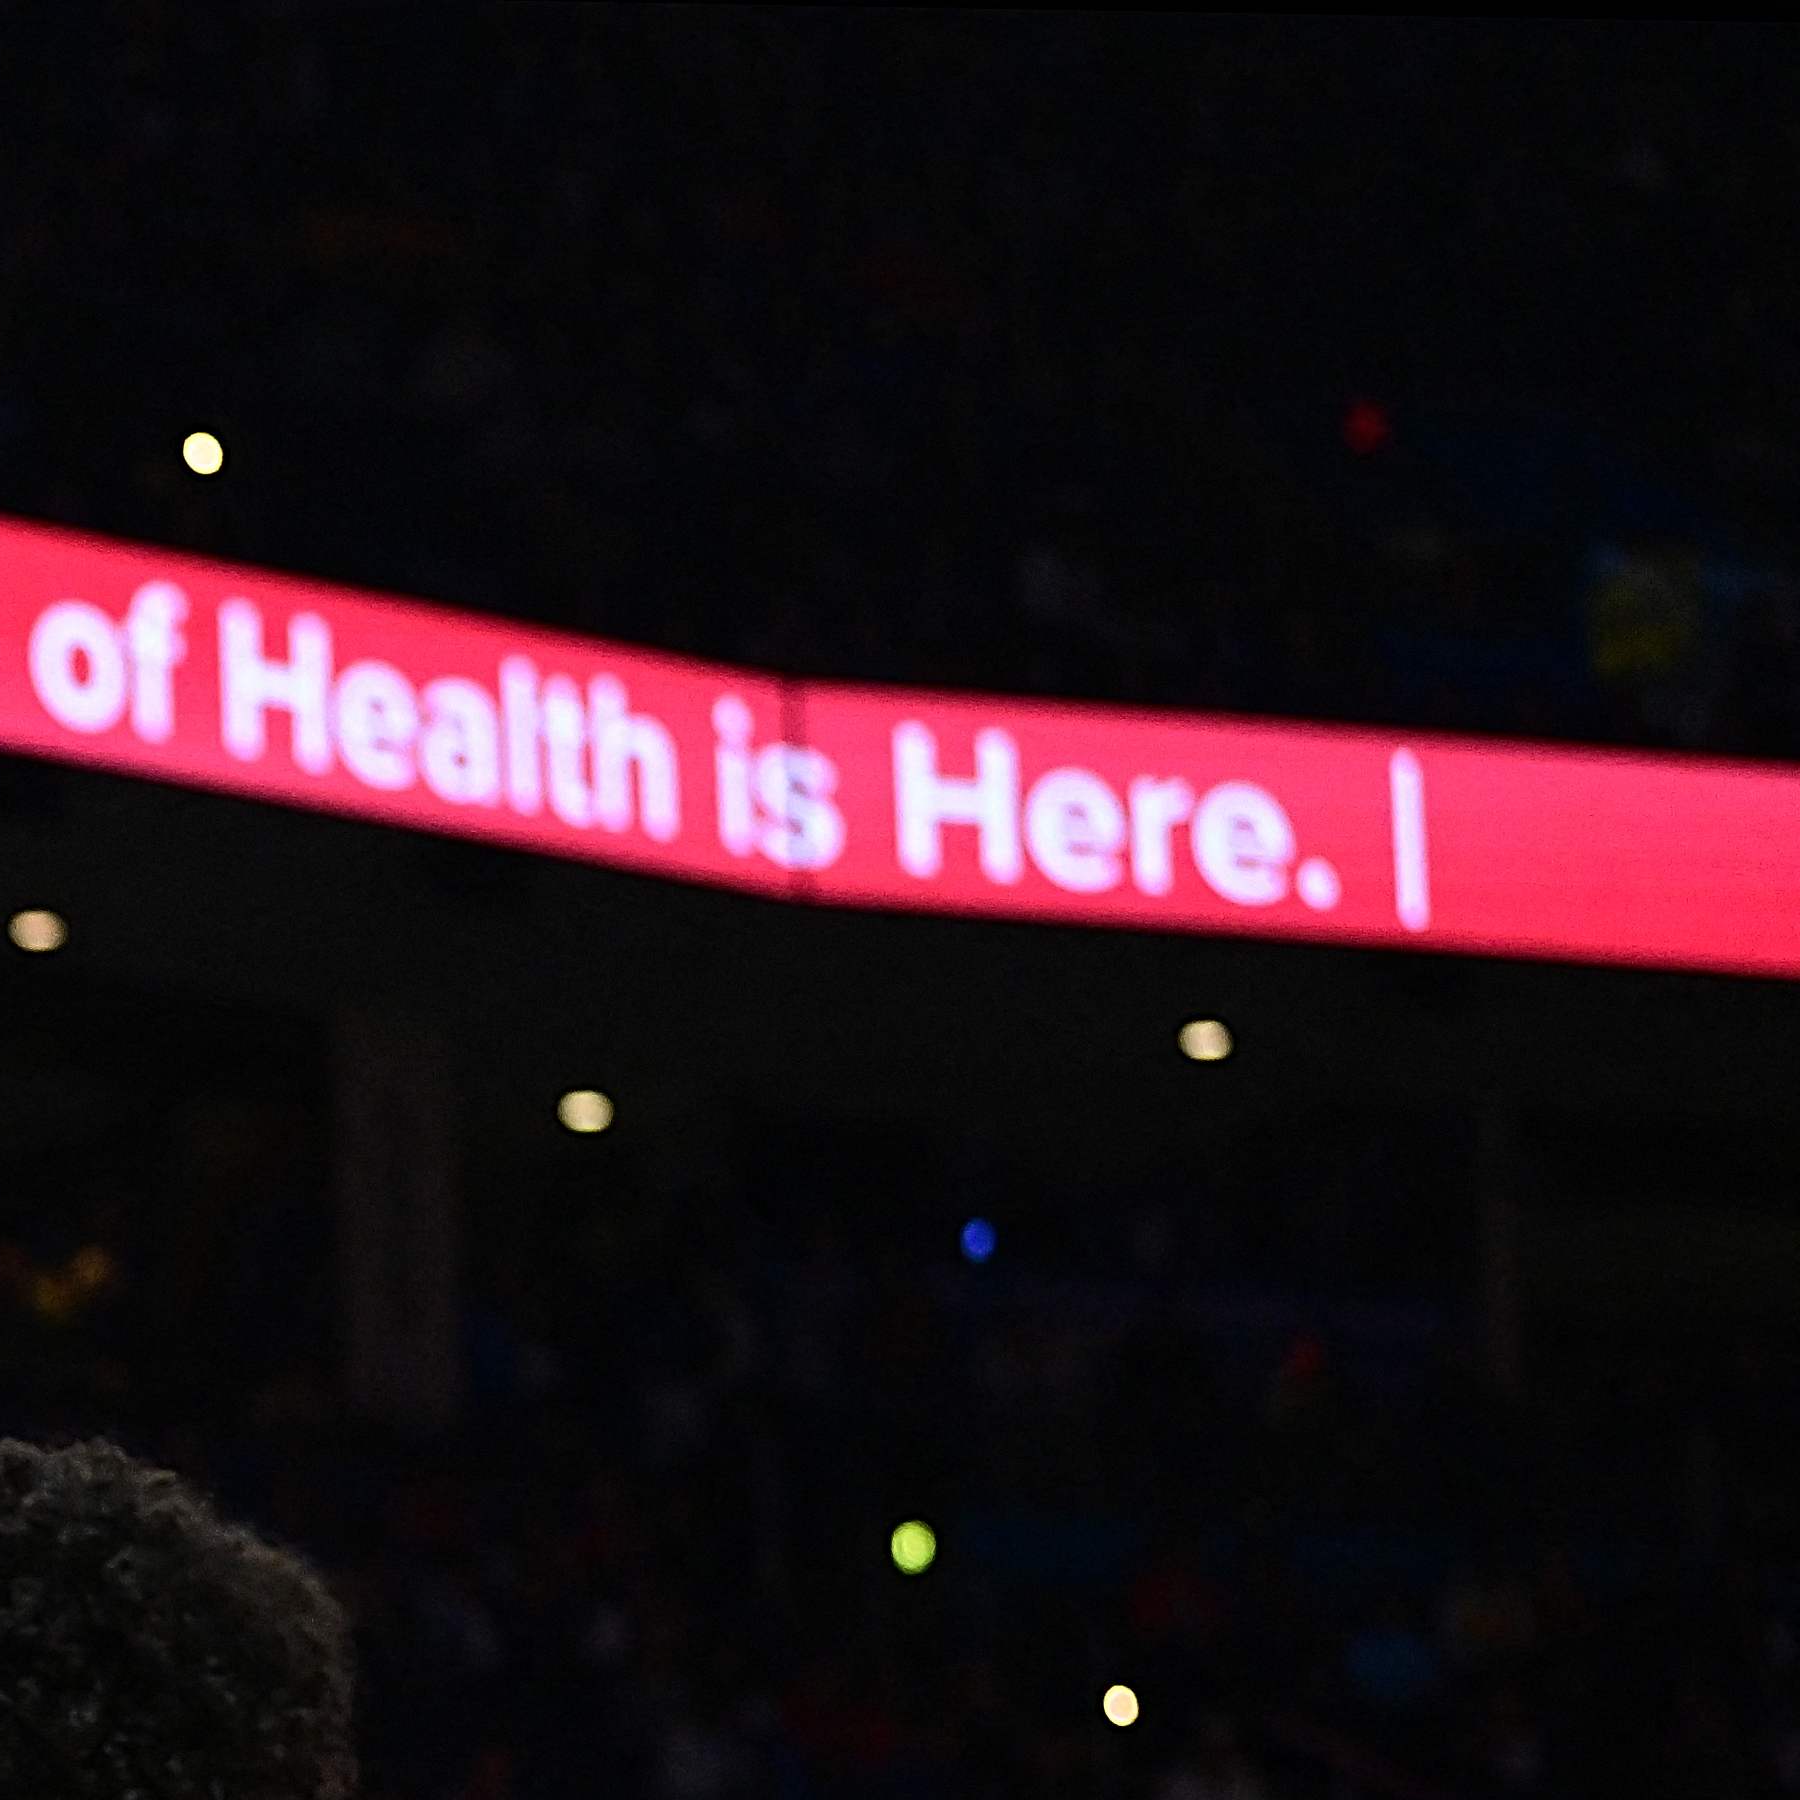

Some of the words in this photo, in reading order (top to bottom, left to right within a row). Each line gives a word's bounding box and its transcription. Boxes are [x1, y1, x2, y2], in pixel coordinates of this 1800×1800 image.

[30, 583, 183, 738] of
[220, 602, 678, 837] Health
[714, 698, 842, 866] is
[893, 722, 1337, 907] Here.
